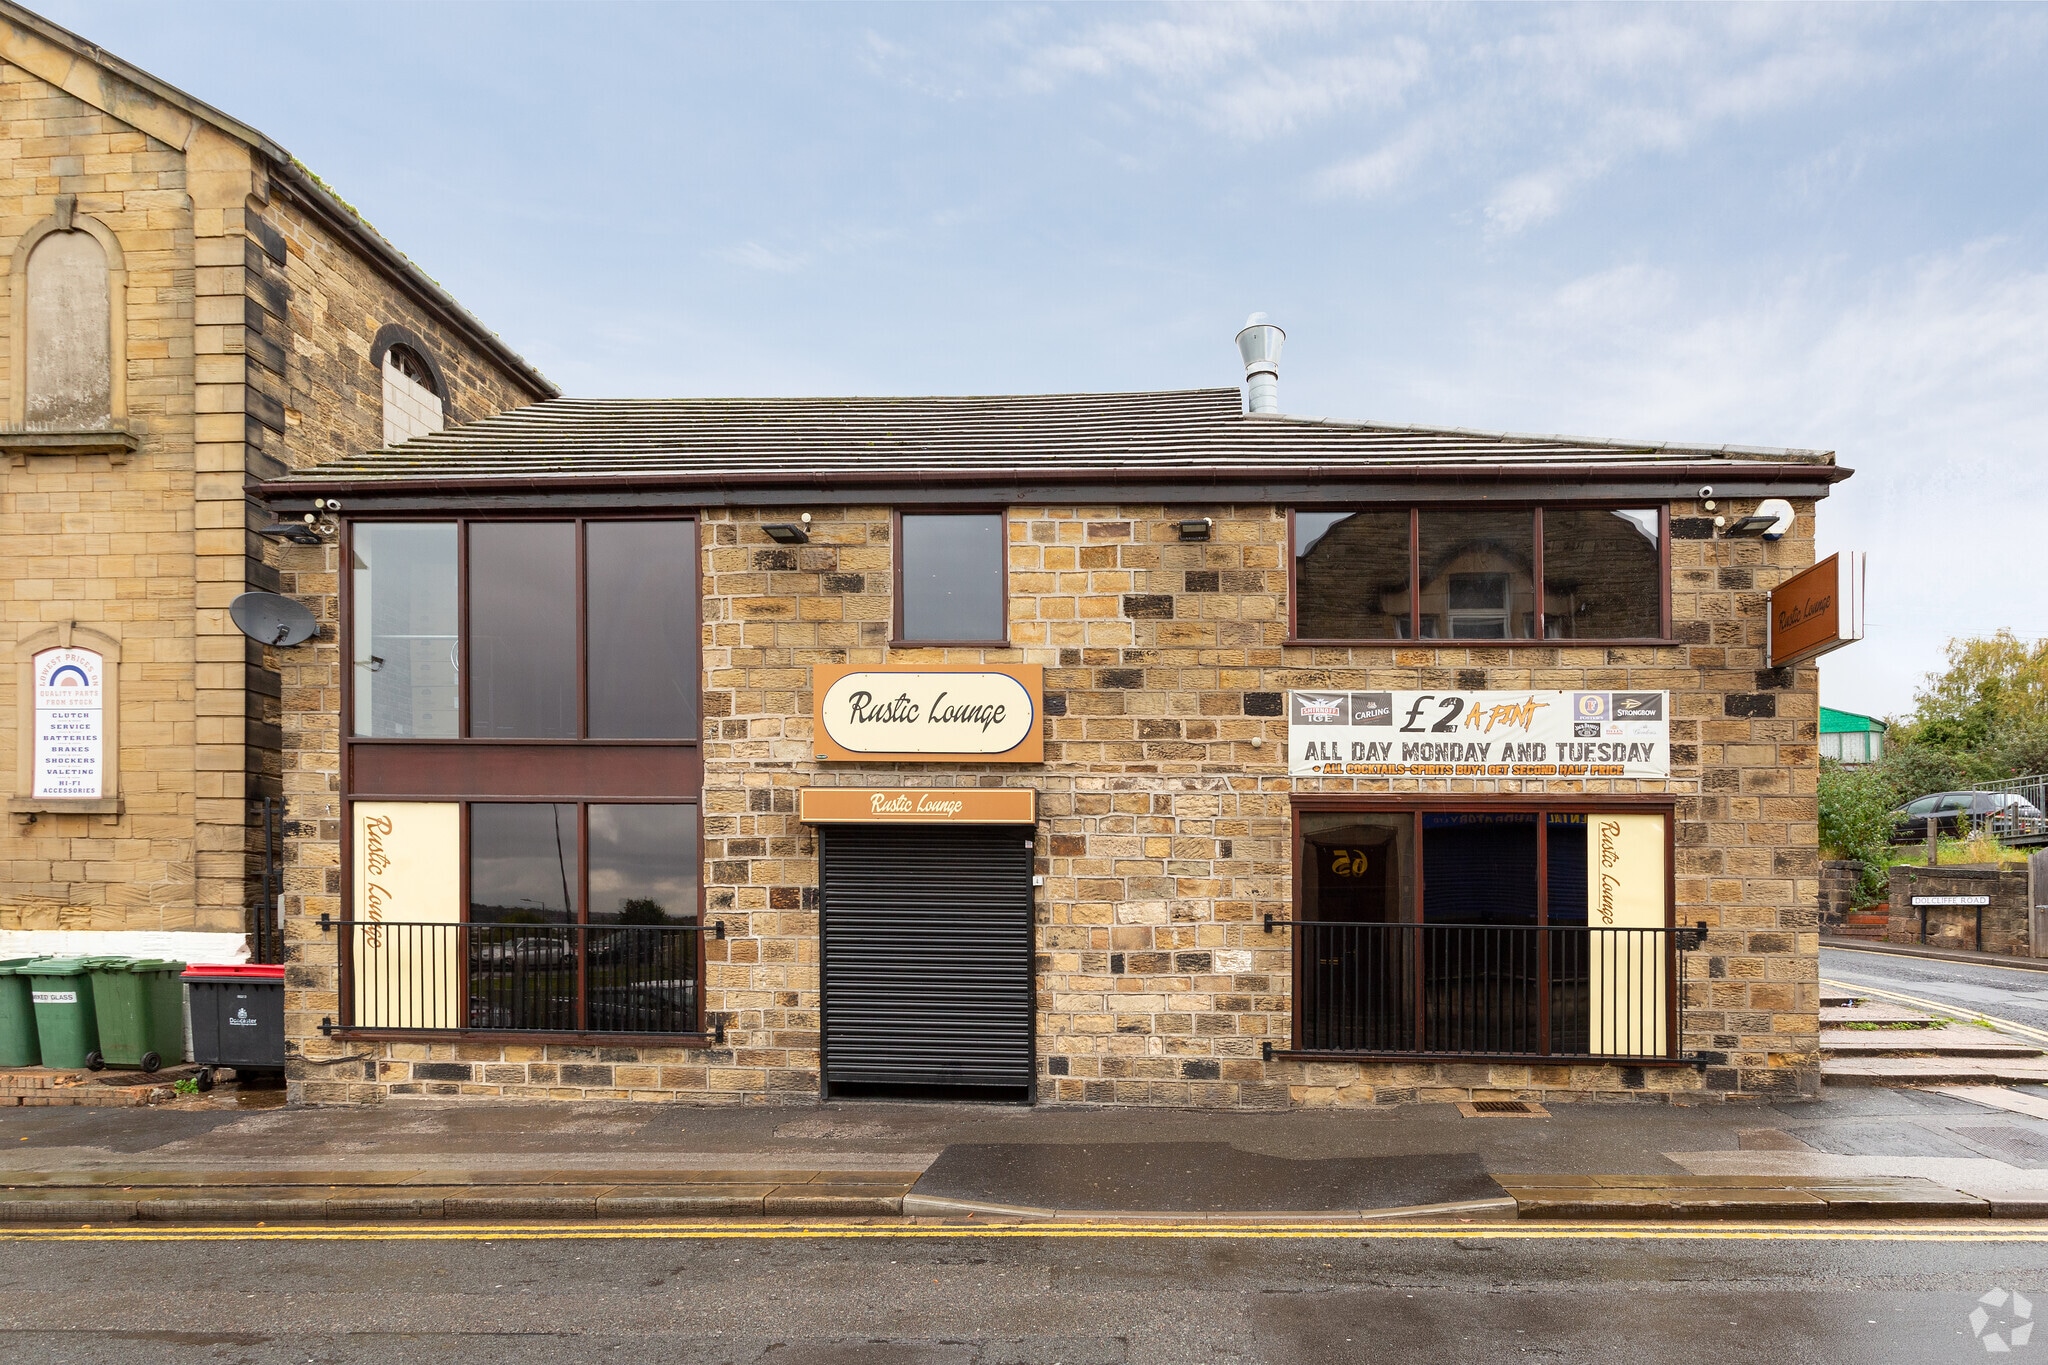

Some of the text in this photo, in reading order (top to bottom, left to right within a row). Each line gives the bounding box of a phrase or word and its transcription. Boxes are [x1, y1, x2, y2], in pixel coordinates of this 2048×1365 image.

[1778, 595, 1831, 631] Rustic Lounge
[40, 654, 99, 686] LOWEST PRICES ON
[849, 691, 1006, 733] Rustic Lounge
[1303, 707, 1338, 715] SMIRNOFF
[1354, 707, 1390, 720] CARLING
[1400, 695, 1550, 734] £2 A PINT
[1617, 709, 1656, 717] STRONGBOW
[1304, 742, 1655, 763] ALL DAY MONDAY AND TUESDAY
[1323, 763, 1344, 775] ALL
[1487, 764, 1510, 775] GET
[1512, 764, 1557, 776] SECOND
[1558, 764, 1588, 776] HALF
[1590, 765, 1624, 776] PRICE
[870, 793, 963, 818] Rustic Lounge
[361, 815, 393, 949] Rustic Lounge
[1597, 820, 1621, 925] Rustic Lounge
[1960, 896, 1986, 904] ROAD
